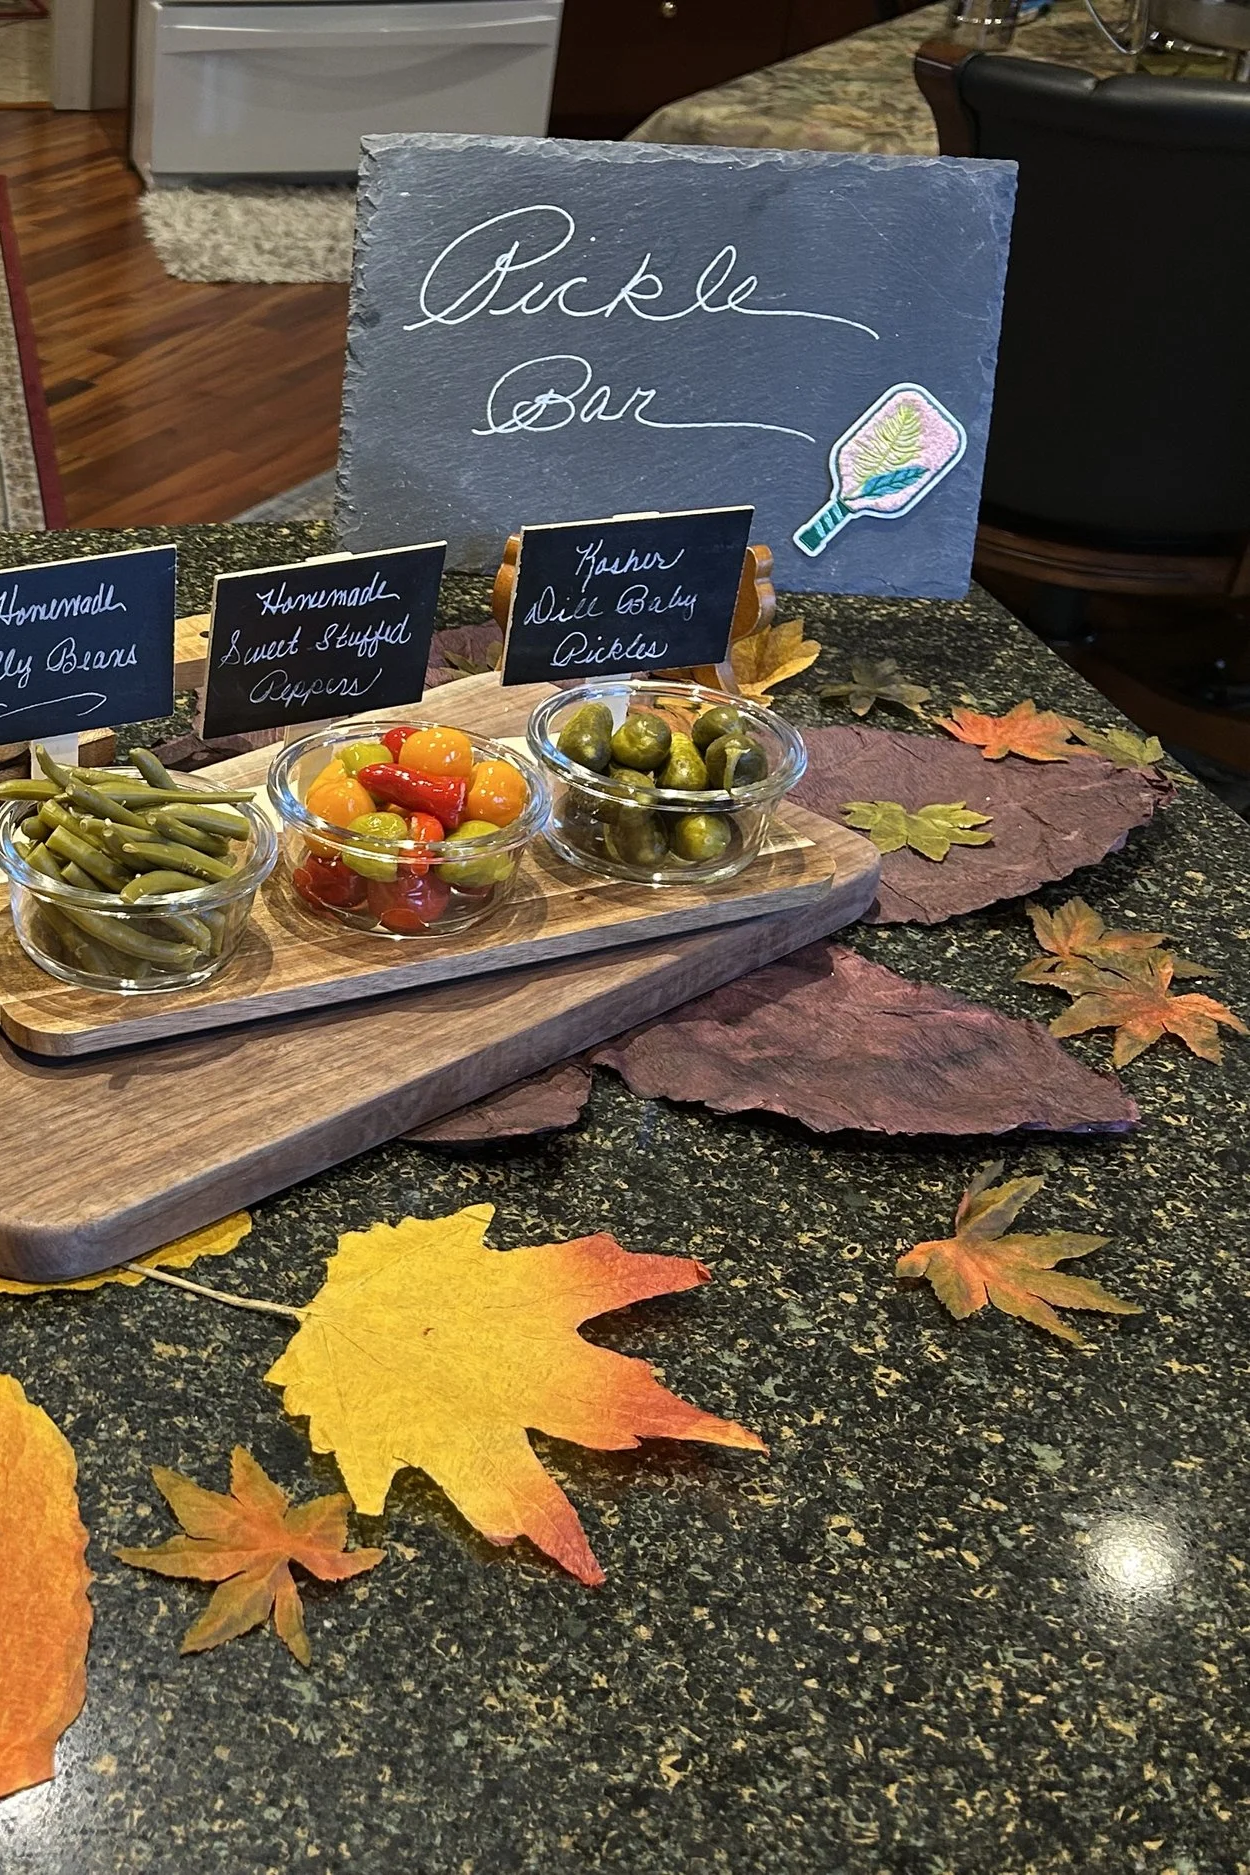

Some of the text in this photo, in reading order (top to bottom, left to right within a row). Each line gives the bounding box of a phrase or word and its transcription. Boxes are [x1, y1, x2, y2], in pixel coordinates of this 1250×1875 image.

[403, 204, 879, 339] Pickle
[472, 355, 815, 442] Bar
[574, 539, 685, 594] Kosher
[256, 571, 401, 616] Homemade
[523, 583, 699, 626] Dill Baby
[46, 637, 138, 674] Beans
[217, 613, 412, 669] Sweet Stuffed
[550, 631, 669, 667] Pickles
[249, 667, 383, 708] Peppers
